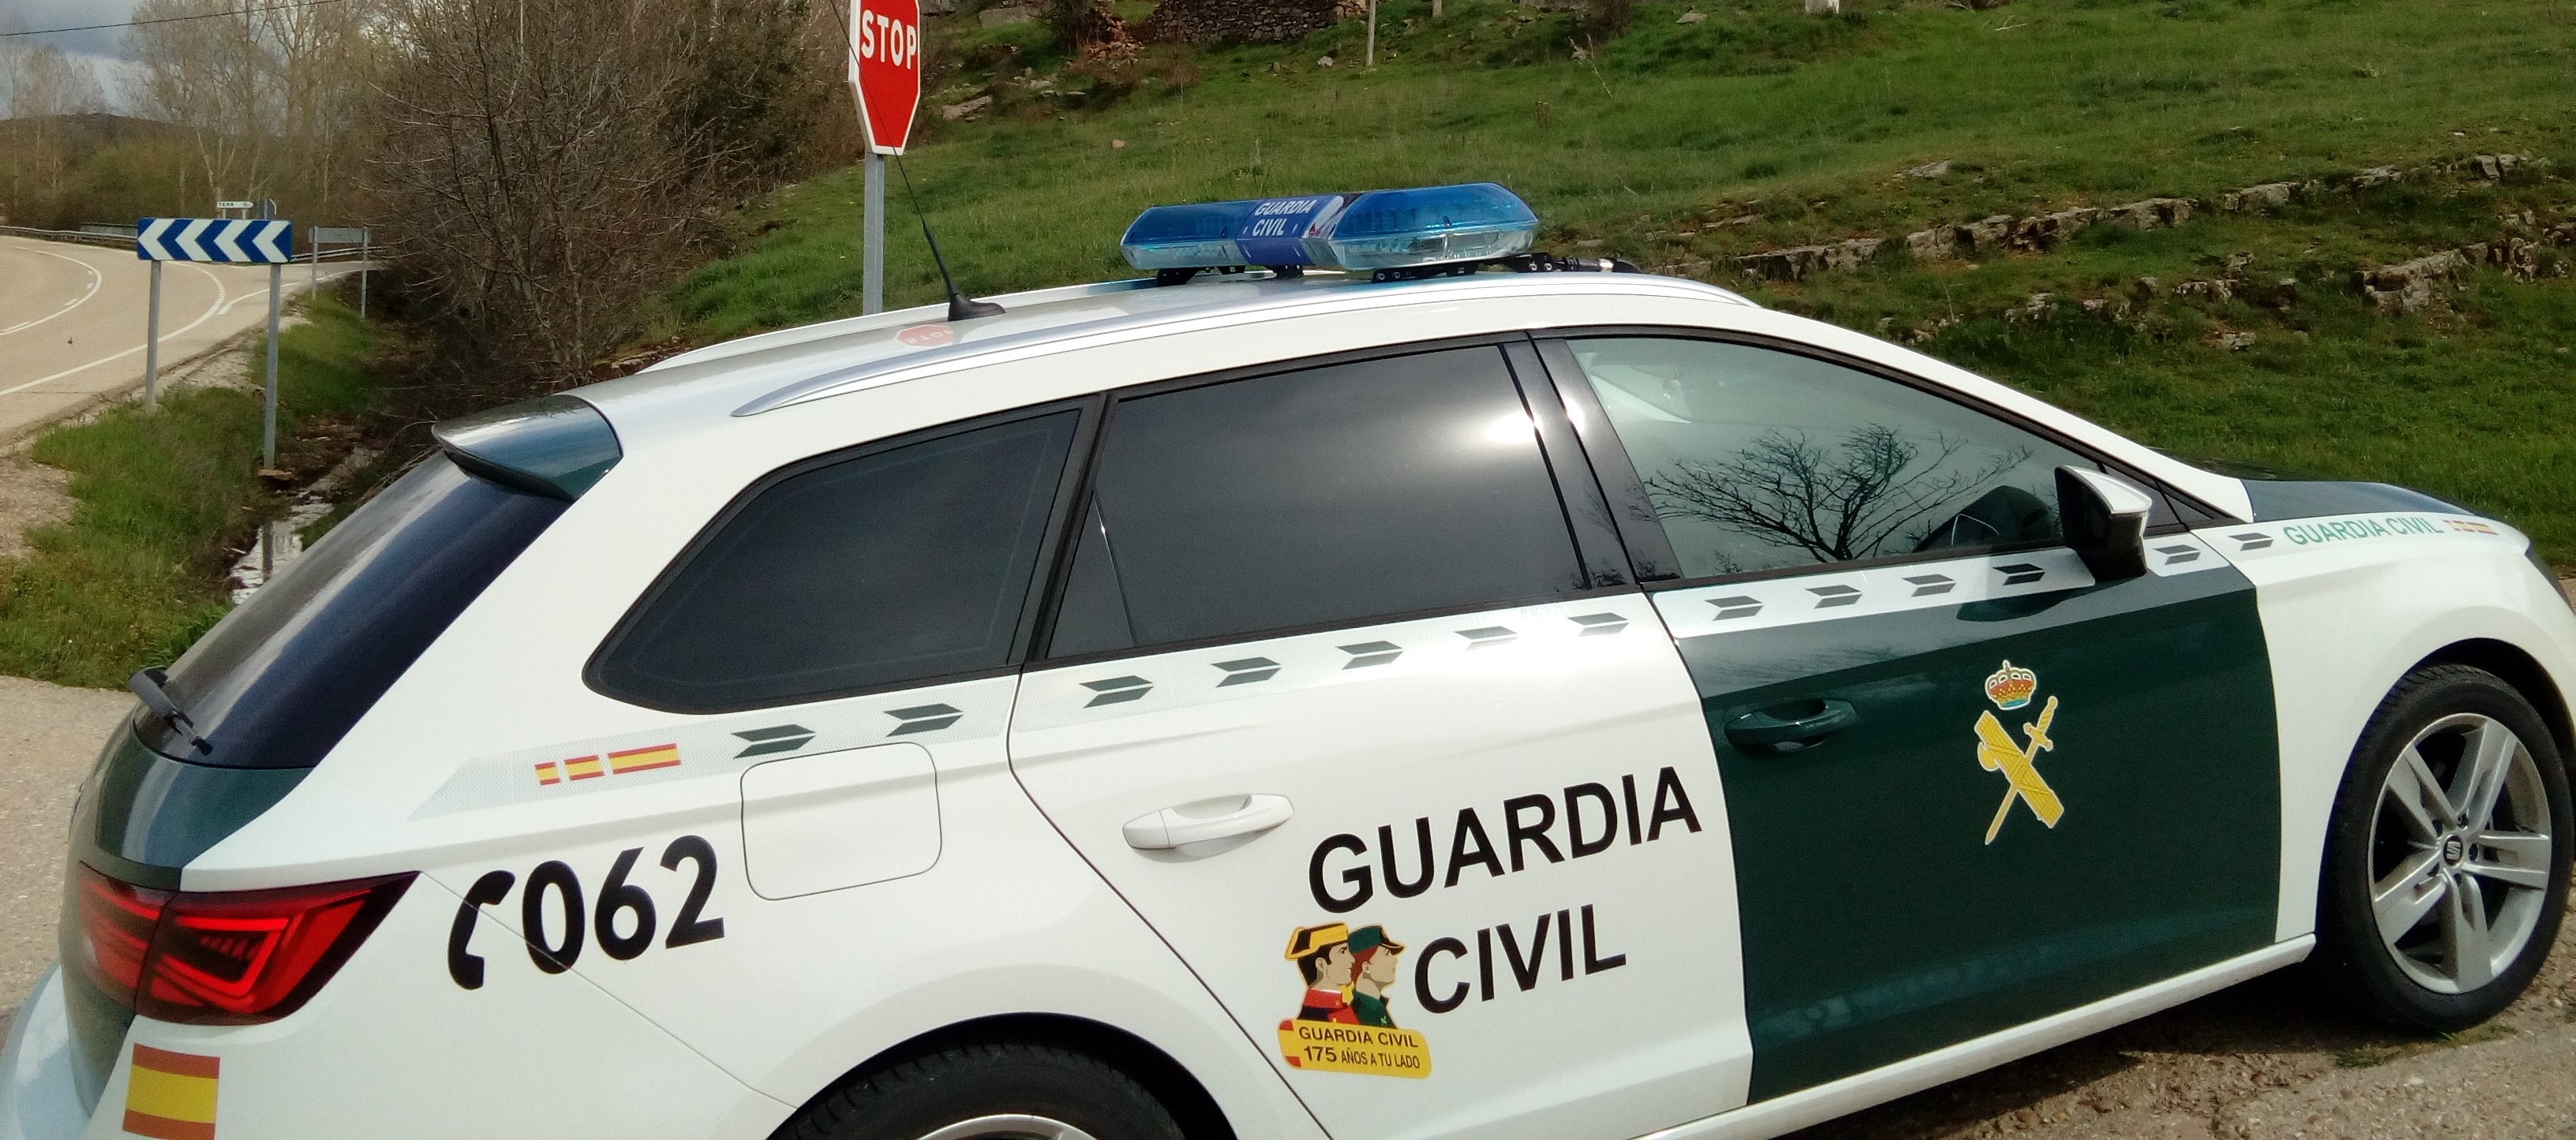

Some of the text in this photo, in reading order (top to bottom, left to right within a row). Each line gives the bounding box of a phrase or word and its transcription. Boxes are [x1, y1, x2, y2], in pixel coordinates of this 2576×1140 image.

[861, 9, 917, 70] STOP
[1254, 199, 1317, 216] GUARDIA
[1252, 218, 1287, 237] CIVIL
[2282, 516, 2445, 545] GUARDIA CIVIL
[1309, 766, 1702, 914] GUARDIA
[522, 835, 725, 975] 062
[1414, 904, 1627, 1014] CIVIL
[1298, 1026, 1419, 1048] GUARDIA CIVIL
[1303, 1046, 1421, 1070] 175 AÑOS A TU LADO
